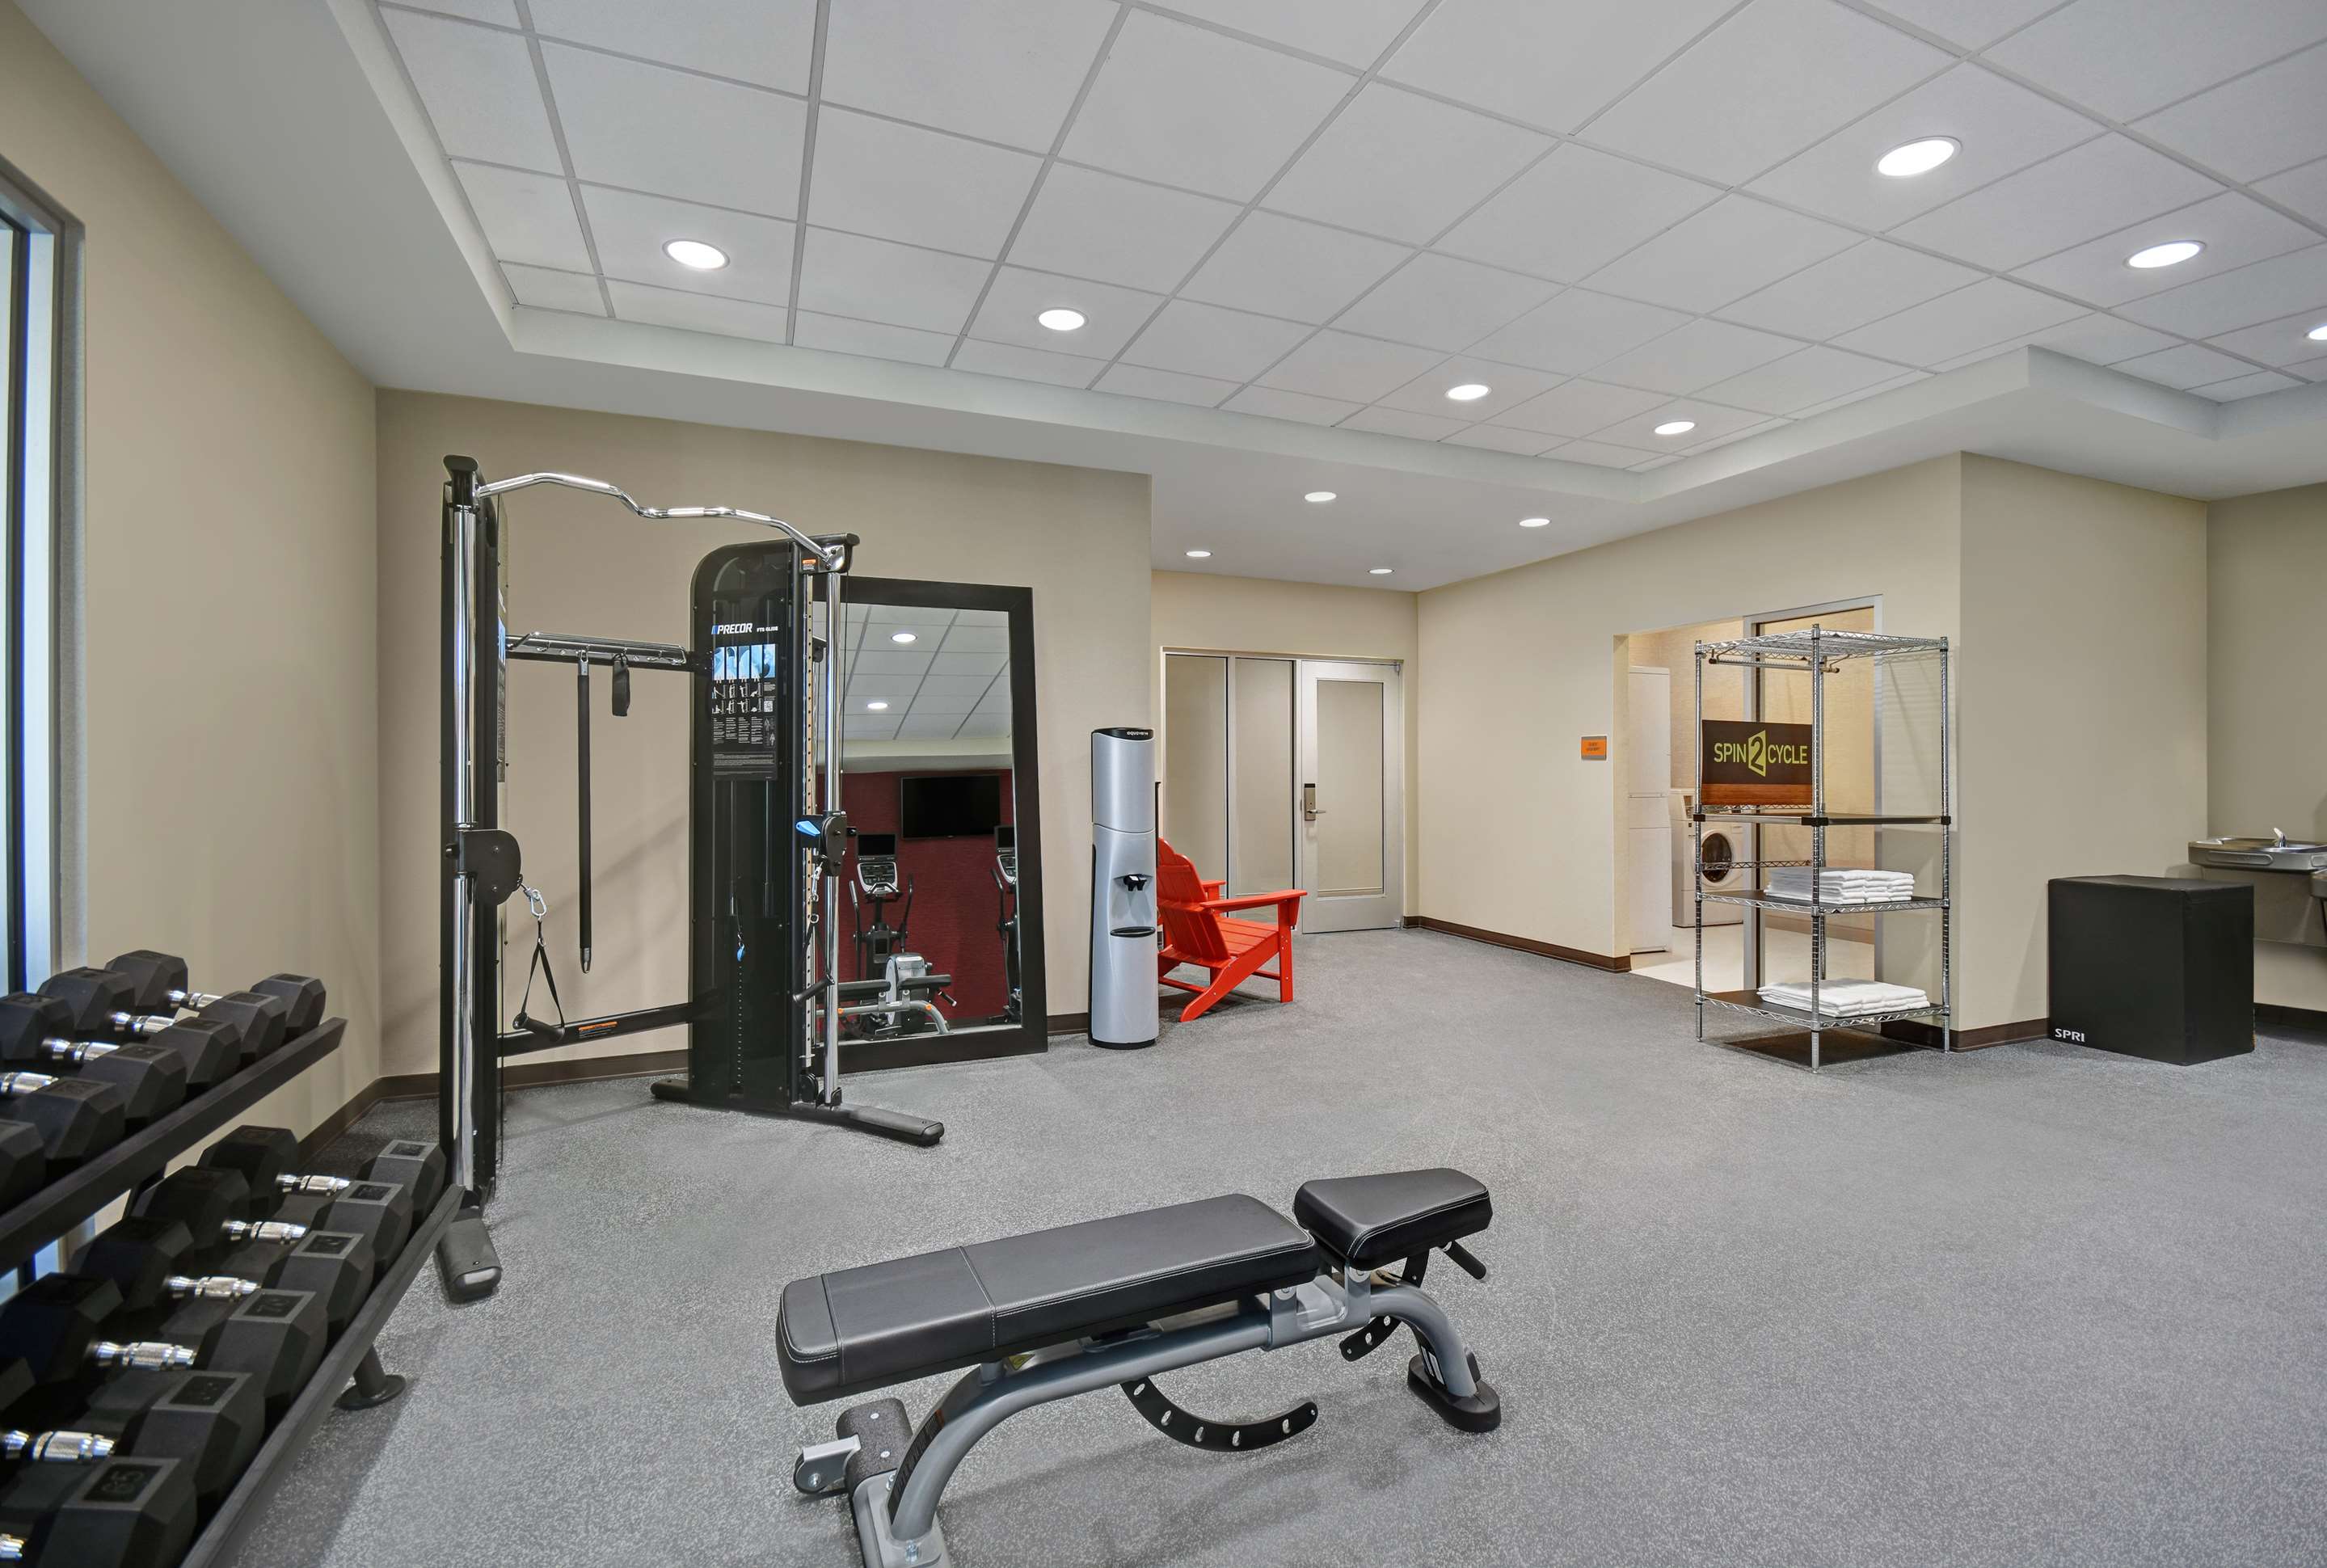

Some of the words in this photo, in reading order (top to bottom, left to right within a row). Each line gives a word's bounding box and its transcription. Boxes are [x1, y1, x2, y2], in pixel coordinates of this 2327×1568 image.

[718, 623, 752, 634] PRECOR
[1714, 743, 1747, 763] SPIN
[1749, 736, 1764, 773] 2
[1768, 744, 1808, 765] CYCLE
[2055, 1028, 2085, 1043] SPRI
